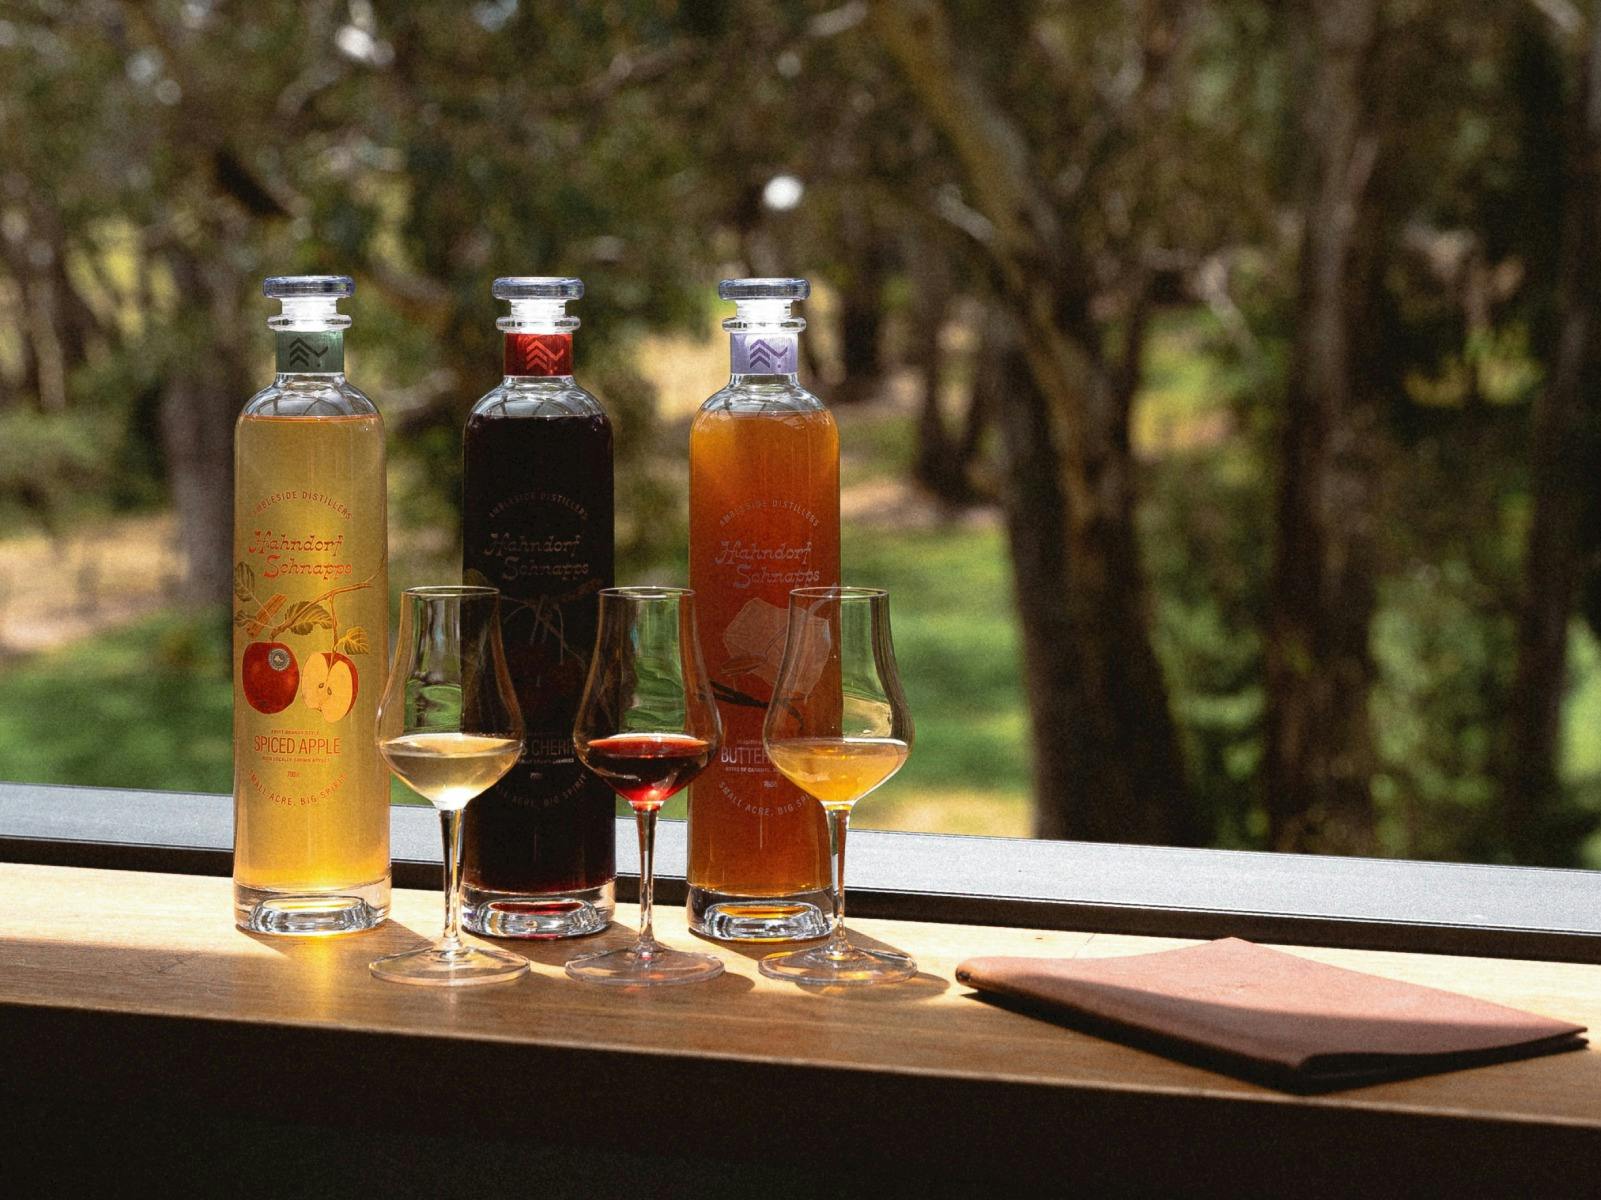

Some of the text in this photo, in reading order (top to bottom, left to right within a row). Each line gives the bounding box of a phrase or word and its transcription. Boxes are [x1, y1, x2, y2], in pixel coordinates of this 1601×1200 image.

[772, 499, 820, 527] DISTILLERS
[248, 528, 344, 557] Hahndorf
[482, 532, 582, 558] Hahndorf
[715, 540, 813, 565] Hahndorf
[263, 554, 352, 580] Schnapps
[735, 564, 820, 588] Schnapps
[254, 735, 342, 755] SPICED APPLE
[531, 738, 575, 757] CHERR
[721, 746, 770, 764] BUTTER
[300, 795, 317, 806] BIG
[719, 782, 743, 809] SMALL
[777, 804, 794, 816] BIG
